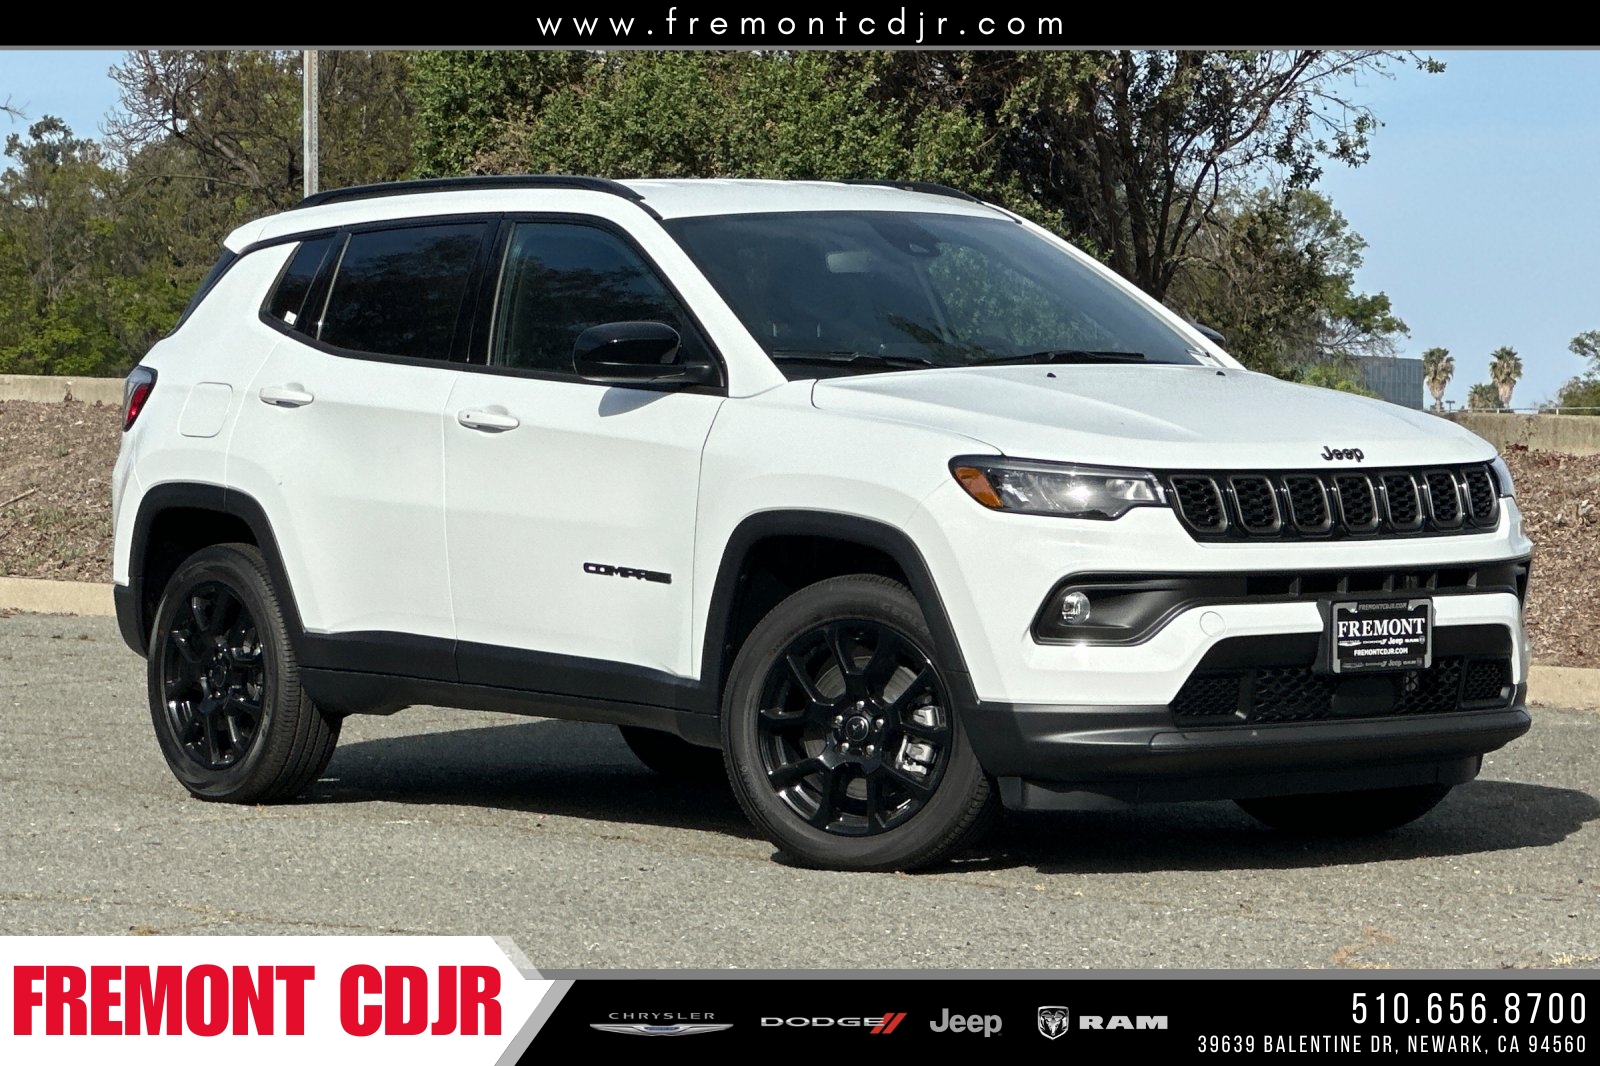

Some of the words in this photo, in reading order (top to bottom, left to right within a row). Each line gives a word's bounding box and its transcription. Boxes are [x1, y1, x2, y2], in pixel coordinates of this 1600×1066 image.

[1321, 446, 1364, 463] Jeep
[1337, 618, 1425, 637] FREMONT
[1388, 636, 1404, 645] Jeep
[1353, 647, 1408, 656] FREMONTCDJR.COM
